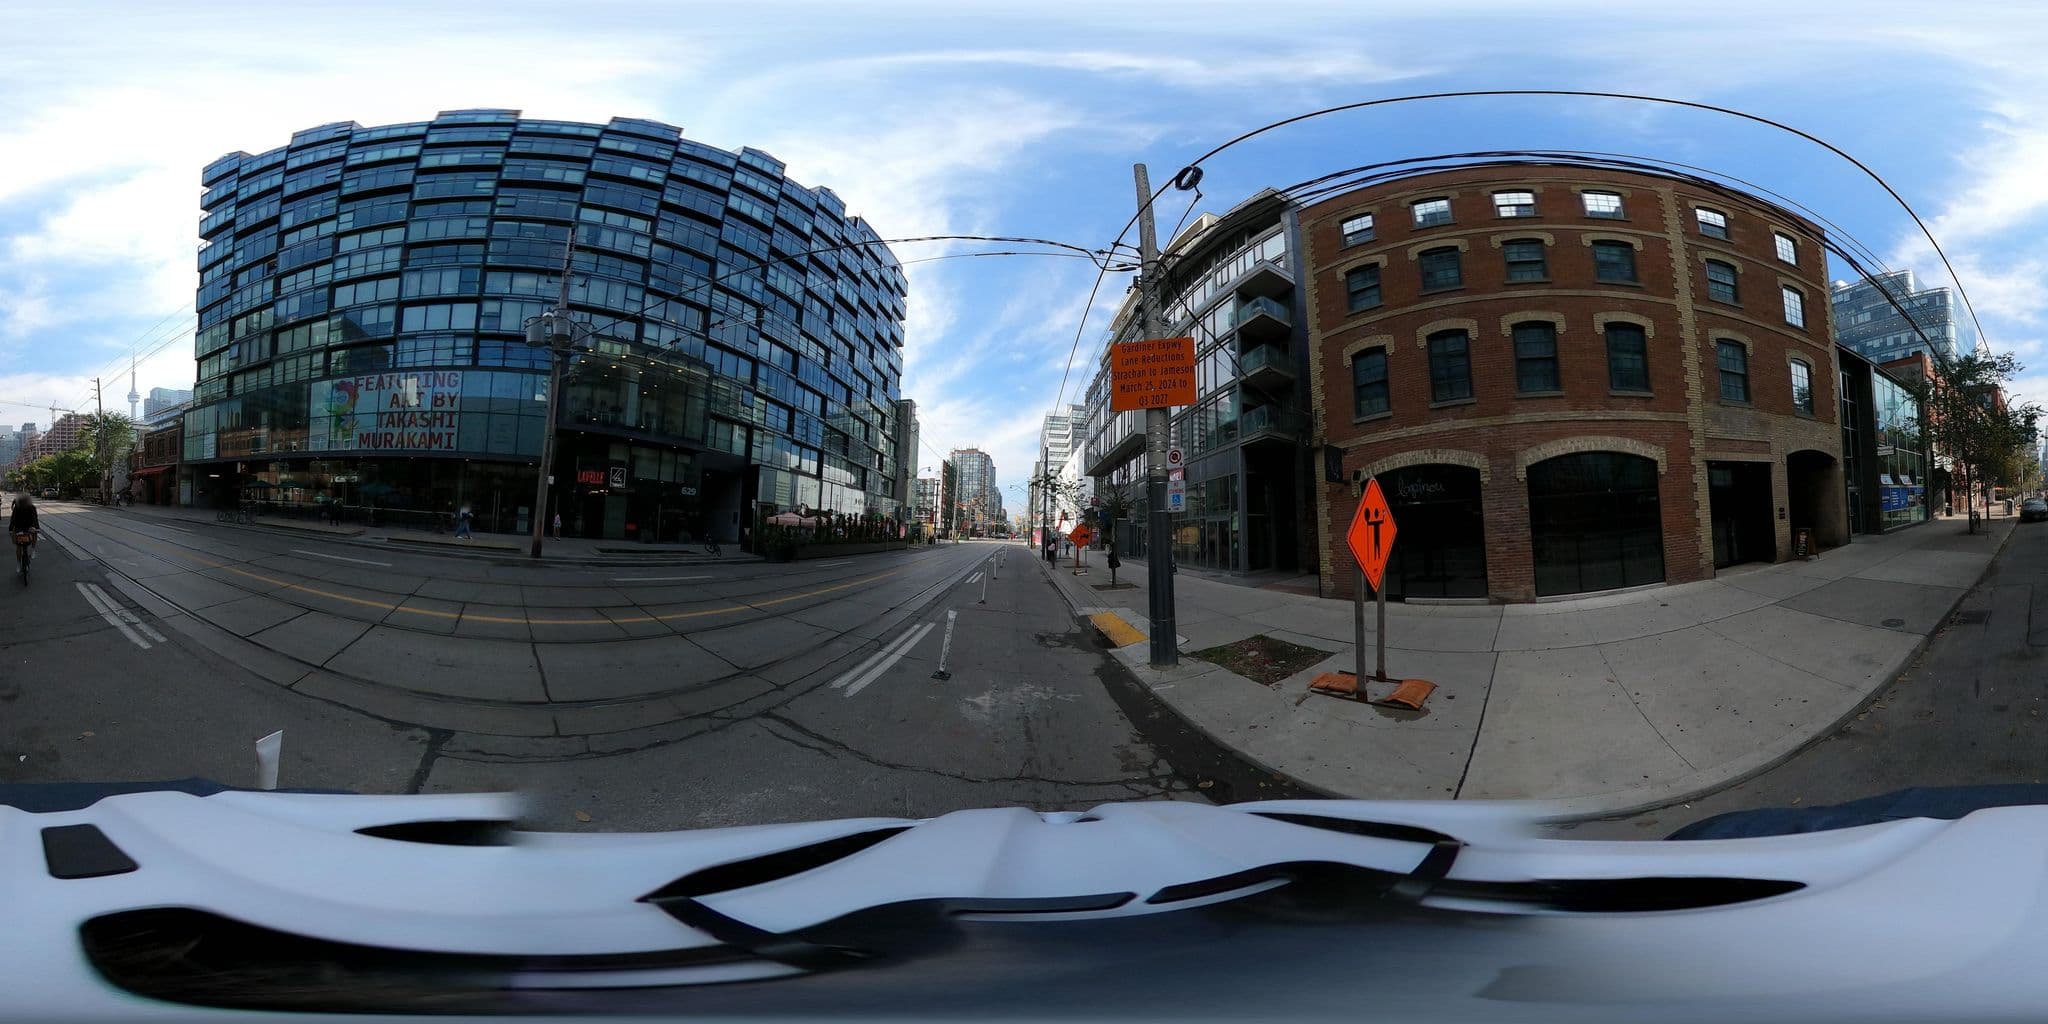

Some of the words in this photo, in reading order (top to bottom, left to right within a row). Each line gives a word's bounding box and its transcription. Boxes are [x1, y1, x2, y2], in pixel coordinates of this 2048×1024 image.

[1121, 342, 1155, 353] Gardiner
[1121, 357, 1139, 366] Lane
[1141, 353, 1184, 364] Reductions
[1113, 368, 1146, 380] Strachan
[1149, 367, 1157, 376] to
[1160, 365, 1194, 376] Jameson
[1120, 382, 1142, 393] March
[1159, 379, 1177, 390] 2024
[1179, 379, 1188, 388] to
[432, 392, 459, 407] BY
[1138, 396, 1148, 406] Q3
[1151, 394, 1168, 405] 2027
[377, 411, 456, 429] TAKASHI
[358, 431, 455, 450] MURAKAMI
[681, 486, 697, 496] 629
